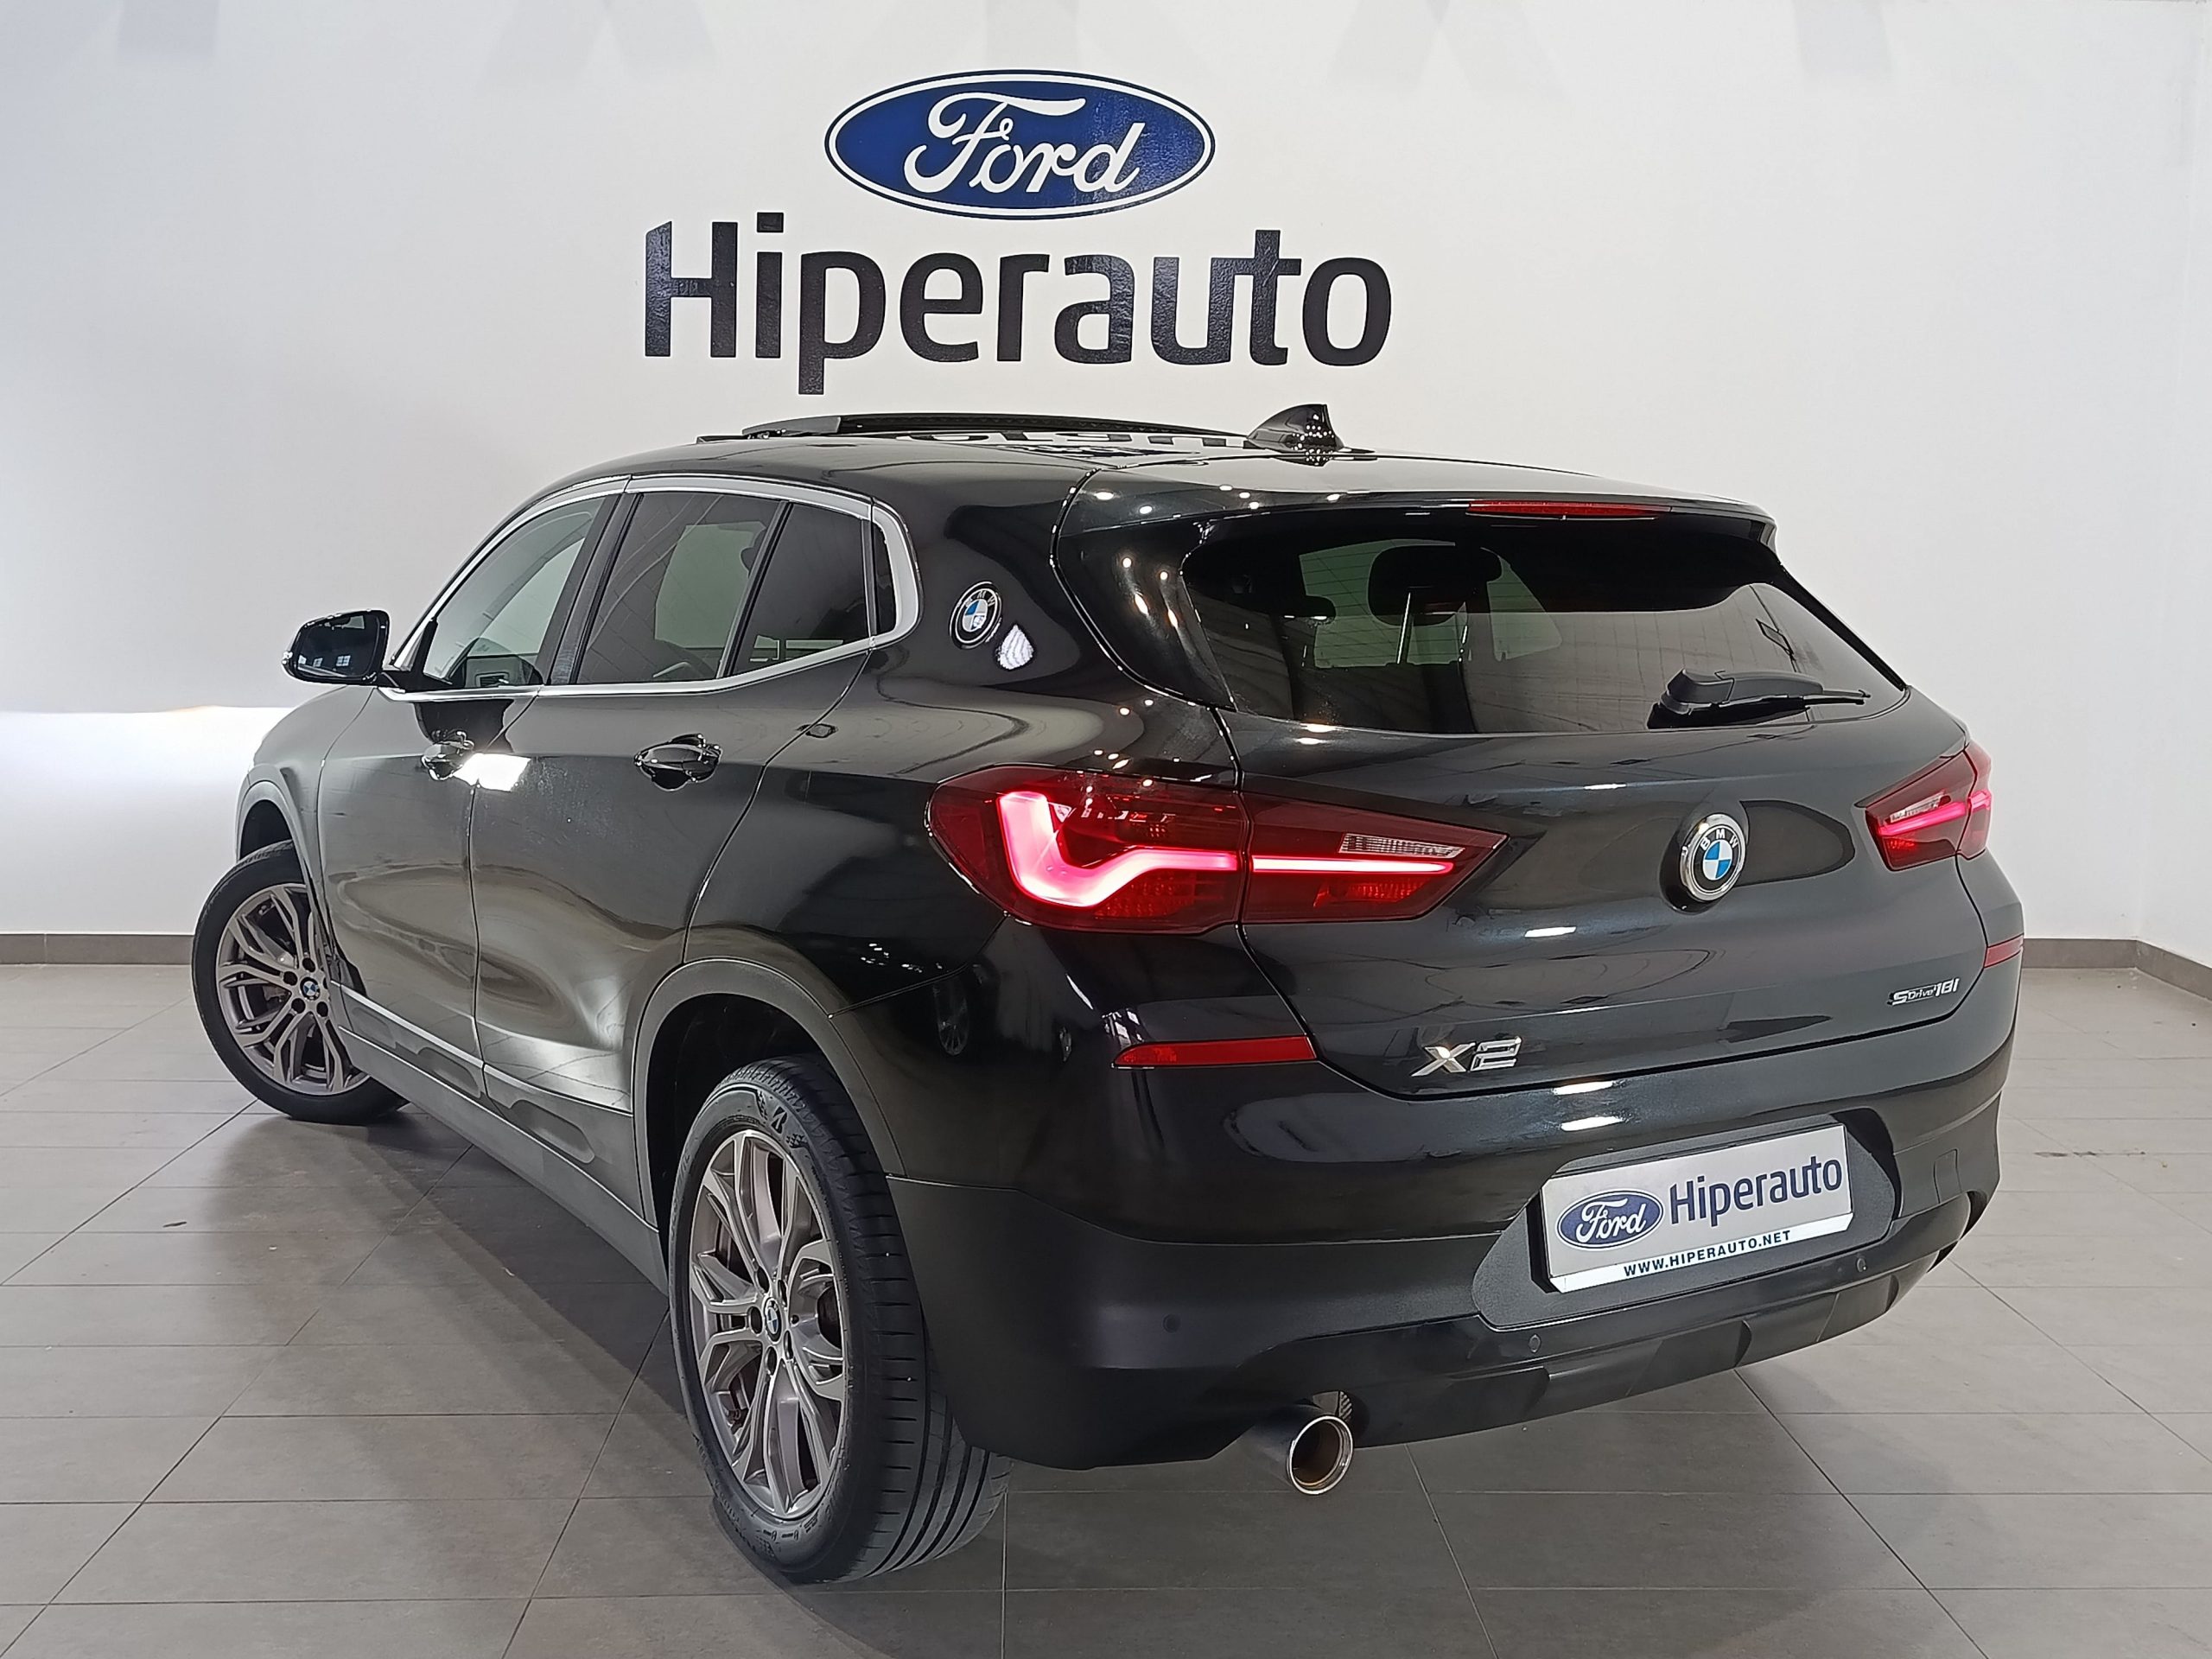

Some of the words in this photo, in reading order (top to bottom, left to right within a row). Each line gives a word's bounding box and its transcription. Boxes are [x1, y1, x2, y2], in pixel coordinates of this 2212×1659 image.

[904, 92, 1147, 194] Ford
[645, 212, 1392, 396] Hiperauto
[1700, 828, 1739, 851] BMW
[1410, 1036, 1522, 1077] X2
[1669, 1155, 1843, 1227] Hiperauto
[1575, 1198, 1647, 1243] Ford
[1624, 1230, 1792, 1277] WWW.HIPERAUTO.NET
